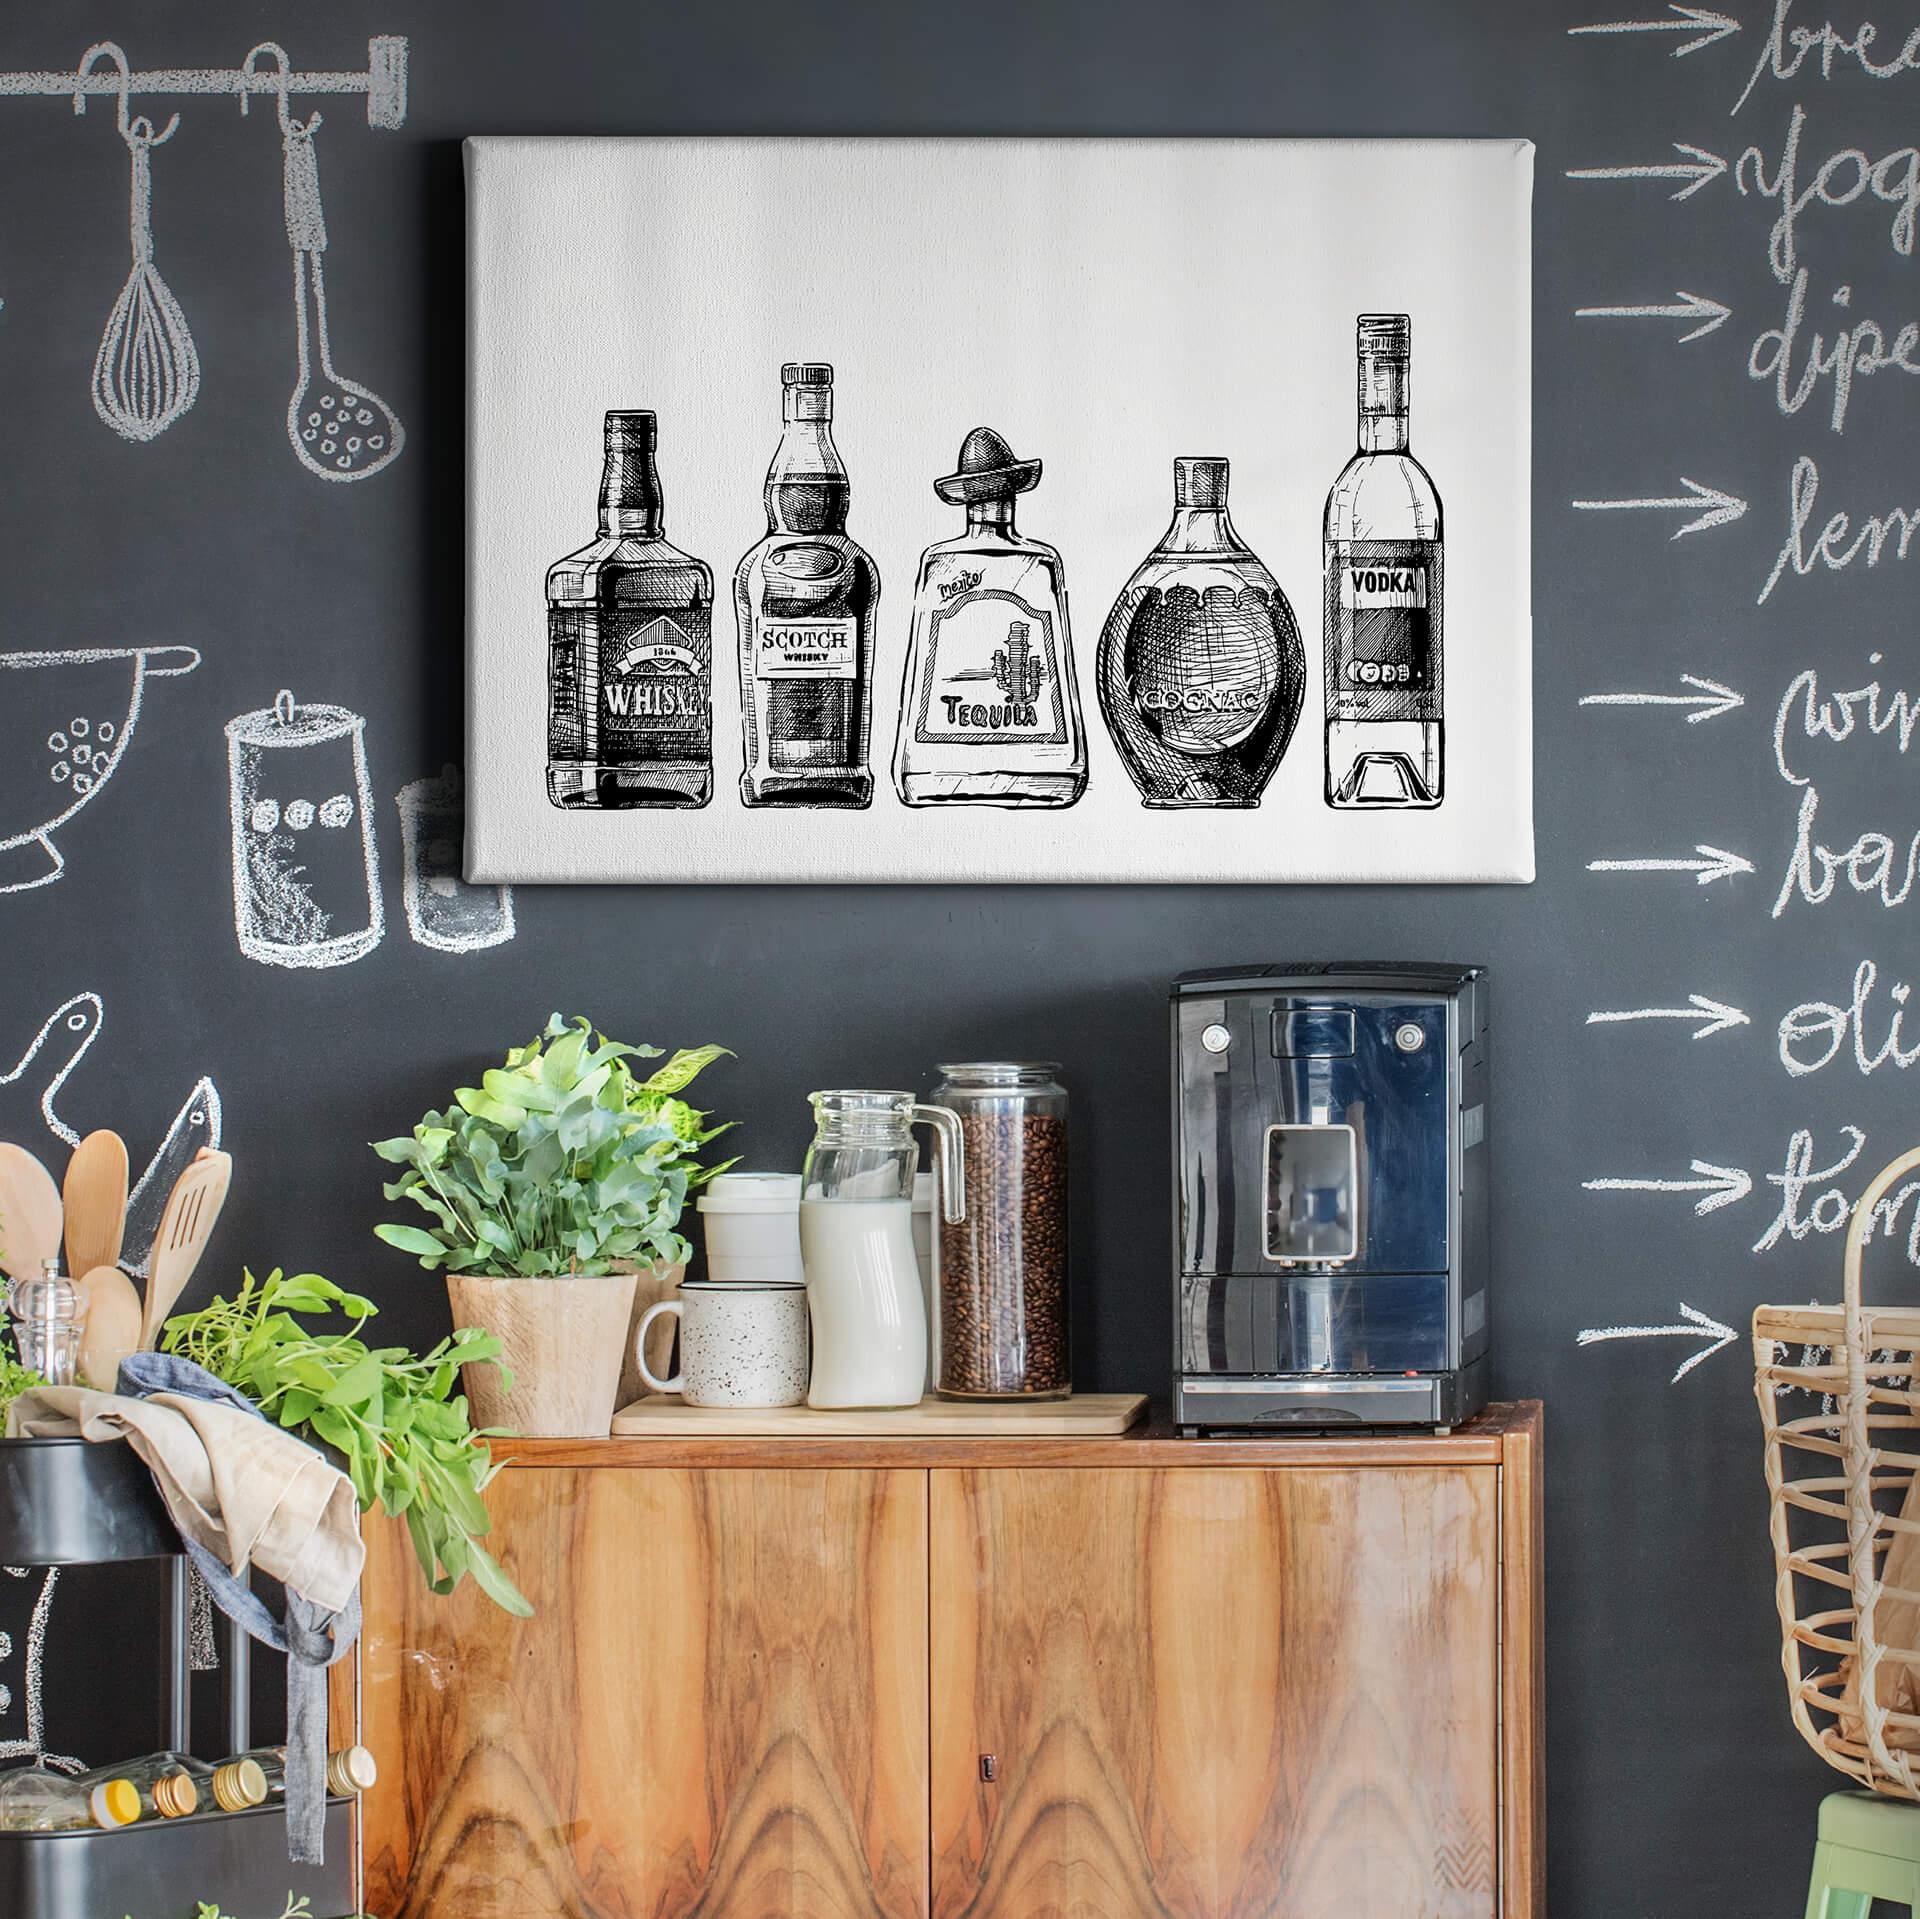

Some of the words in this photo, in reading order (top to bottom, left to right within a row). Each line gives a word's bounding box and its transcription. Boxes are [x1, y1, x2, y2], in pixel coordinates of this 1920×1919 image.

[1351, 570, 1416, 593] VODKA
[762, 628, 848, 651] SCOTCH
[784, 653, 829, 662] WHISKY
[604, 684, 707, 715] WHISKEY
[1143, 690, 1260, 712] COGNAC
[940, 695, 1038, 729] TEQUILA
